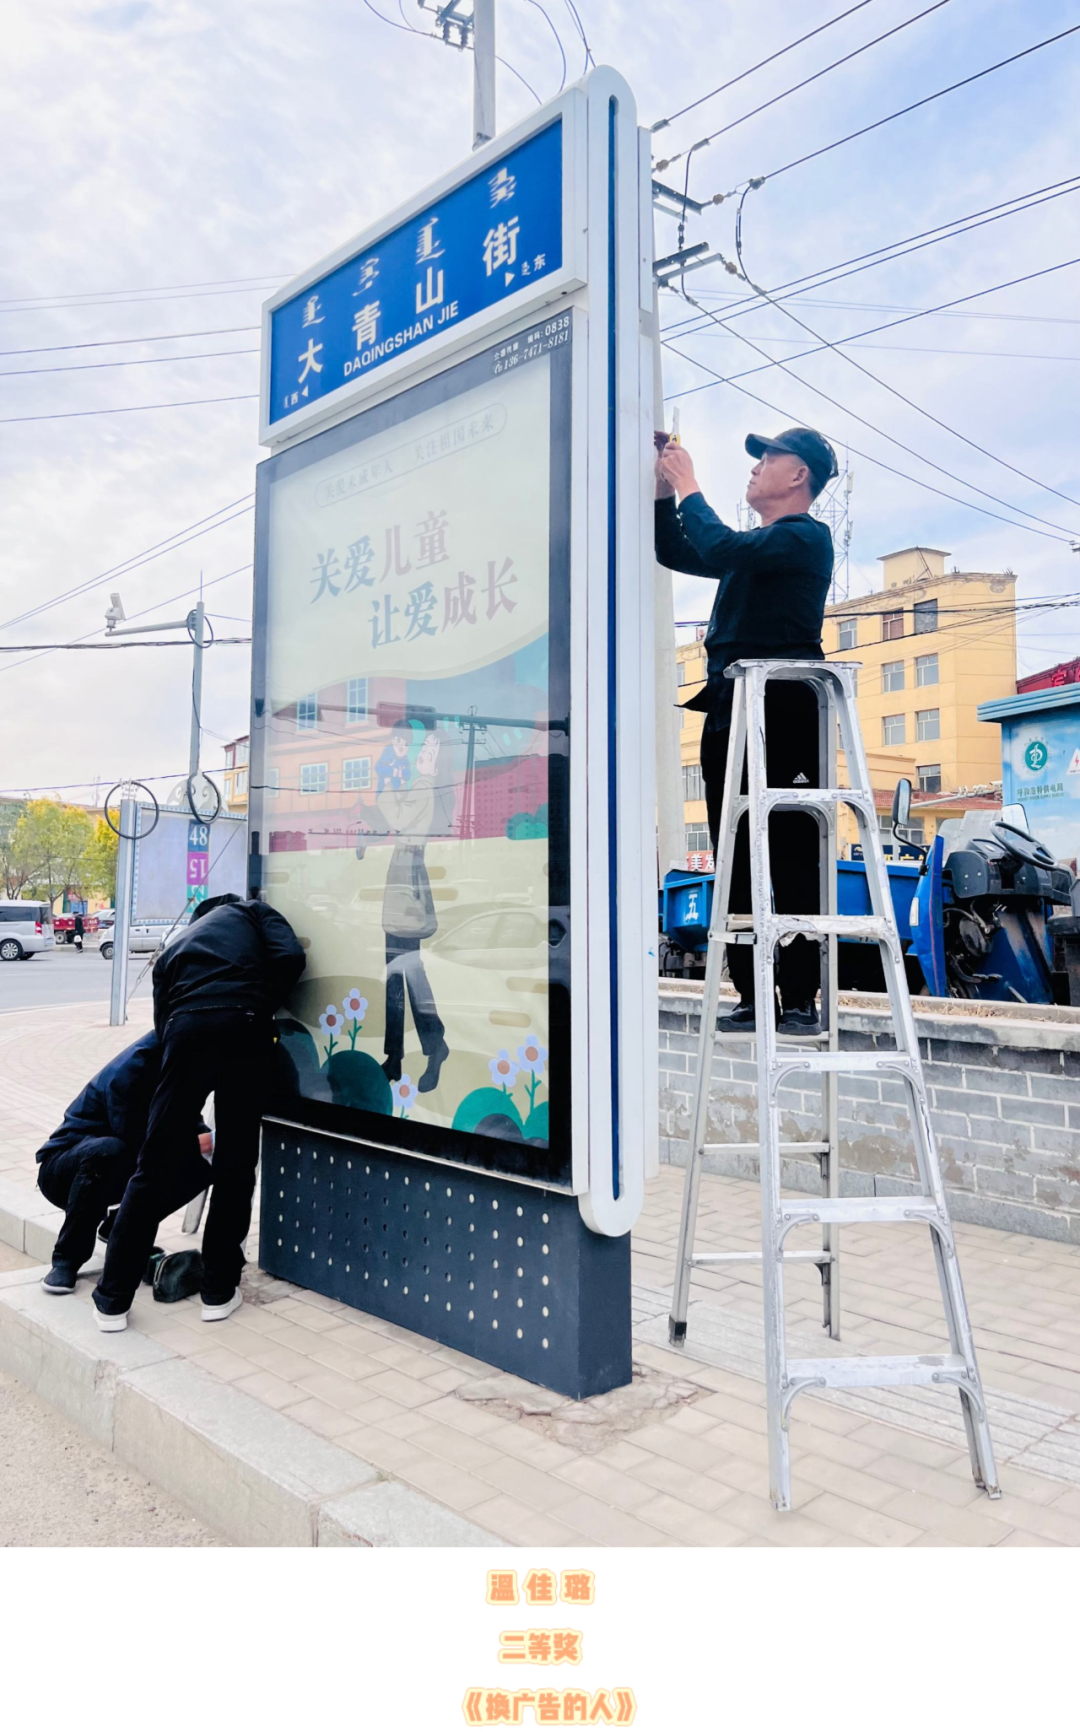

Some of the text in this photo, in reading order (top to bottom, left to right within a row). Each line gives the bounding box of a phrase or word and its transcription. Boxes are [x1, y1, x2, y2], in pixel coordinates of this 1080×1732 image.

[534, 253, 546, 272] 东
[297, 216, 521, 384] 大青山街
[343, 301, 459, 377] DAQINGSHAN JIE
[291, 391, 299, 406] 西
[324, 413, 494, 501] 关爱未成年人 关注祖国未来
[309, 509, 450, 605] 关爱儿童
[367, 556, 518, 649] 让爱成长
[189, 826, 208, 846] 48
[189, 858, 206, 879] 15
[687, 853, 713, 872] 美发
